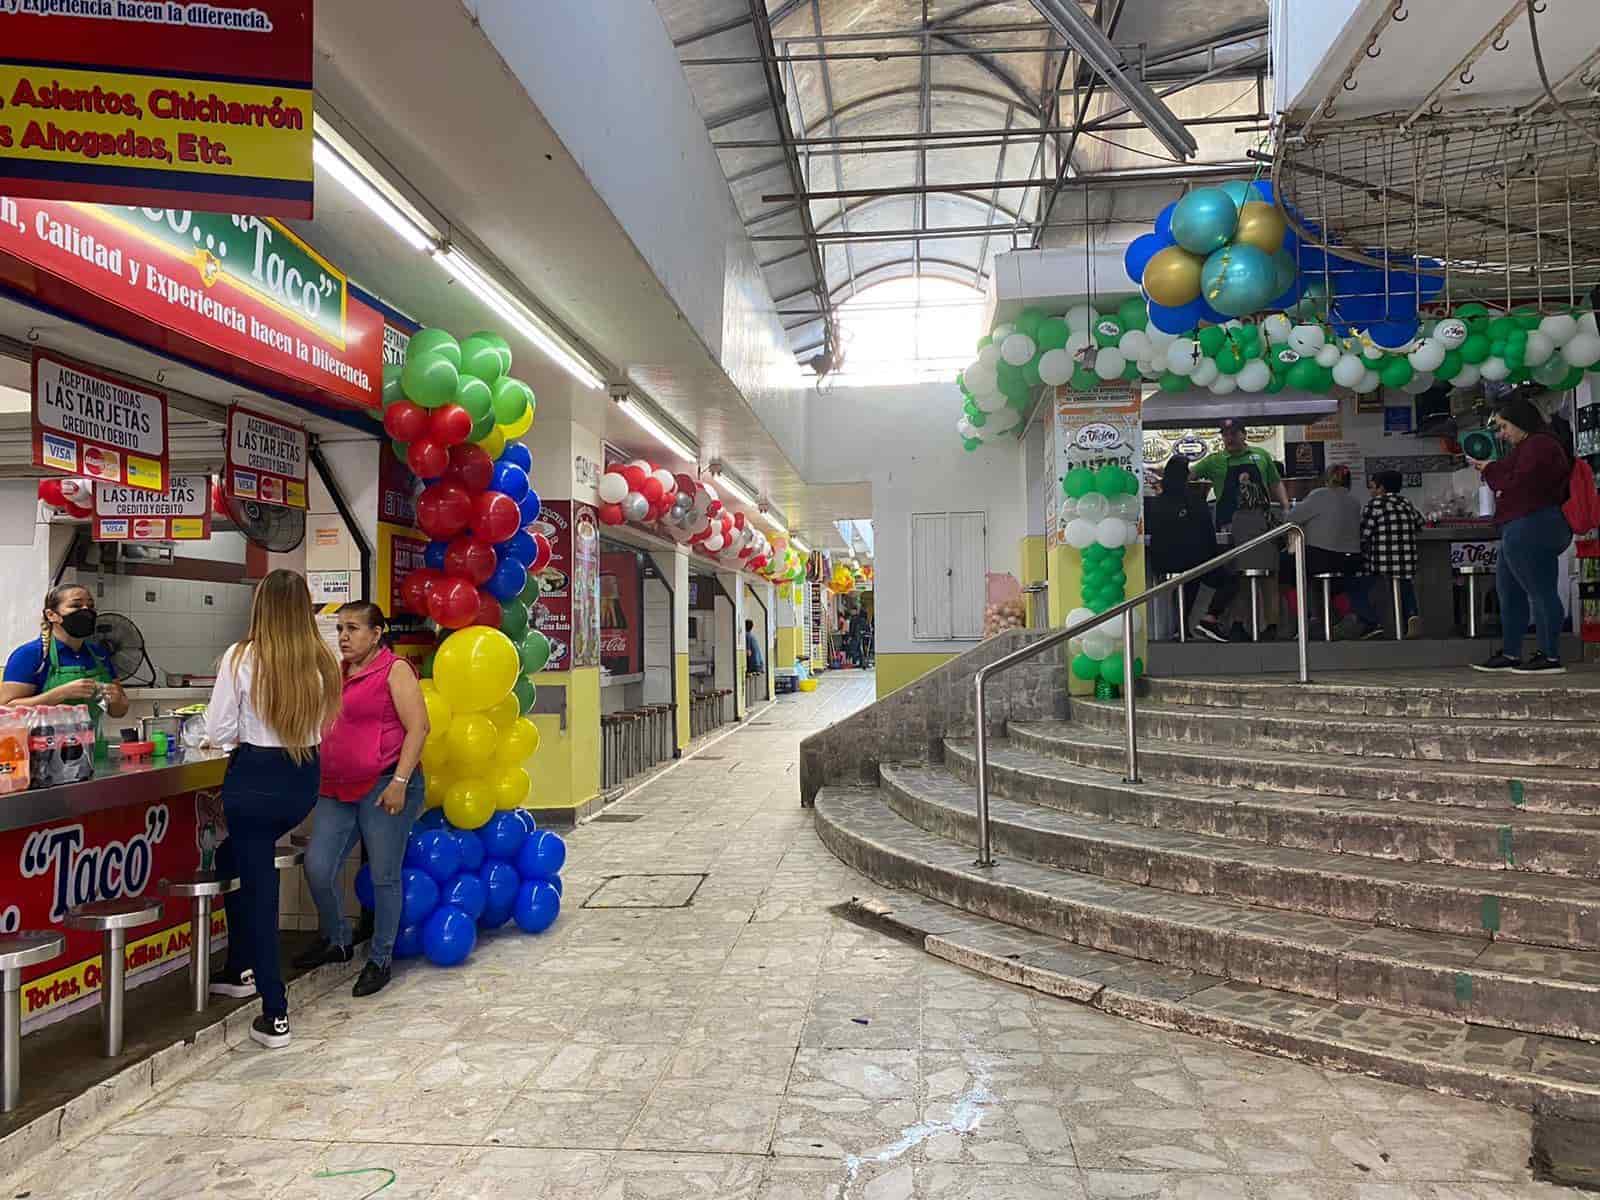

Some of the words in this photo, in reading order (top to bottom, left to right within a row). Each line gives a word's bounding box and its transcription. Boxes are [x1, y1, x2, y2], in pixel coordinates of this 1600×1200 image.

[167, 4, 182, 22] la
[10, 78, 143, 120] Asientos,
[148, 89, 304, 130] Chicharrón
[20, 120, 173, 164] Ahogadas,
[177, 132, 232, 166] Etc.
[35, 210, 123, 277] Calidad
[128, 258, 140, 286] y
[146, 263, 248, 334] Experiencia
[250, 315, 292, 356] hacen
[296, 338, 309, 363] la
[312, 345, 372, 392] Diferencia.
[59, 368, 112, 401] ACEPTAMOS
[112, 386, 142, 409] TODAS
[46, 381, 75, 412] LAS
[76, 392, 150, 434] TARJETAS
[62, 414, 99, 439] CREDITO
[99, 425, 107, 440] Y
[107, 427, 138, 449] DEBITO
[237, 430, 258, 451] LAS
[259, 436, 301, 463] TARJETAS
[49, 444, 72, 461] VISA
[103, 489, 128, 503] LAS
[171, 478, 188, 488] DAS
[116, 503, 149, 514] CREDITO
[149, 503, 156, 514] Y
[155, 503, 184, 514] DEBITO
[26, 974, 82, 1013] Tortas,
